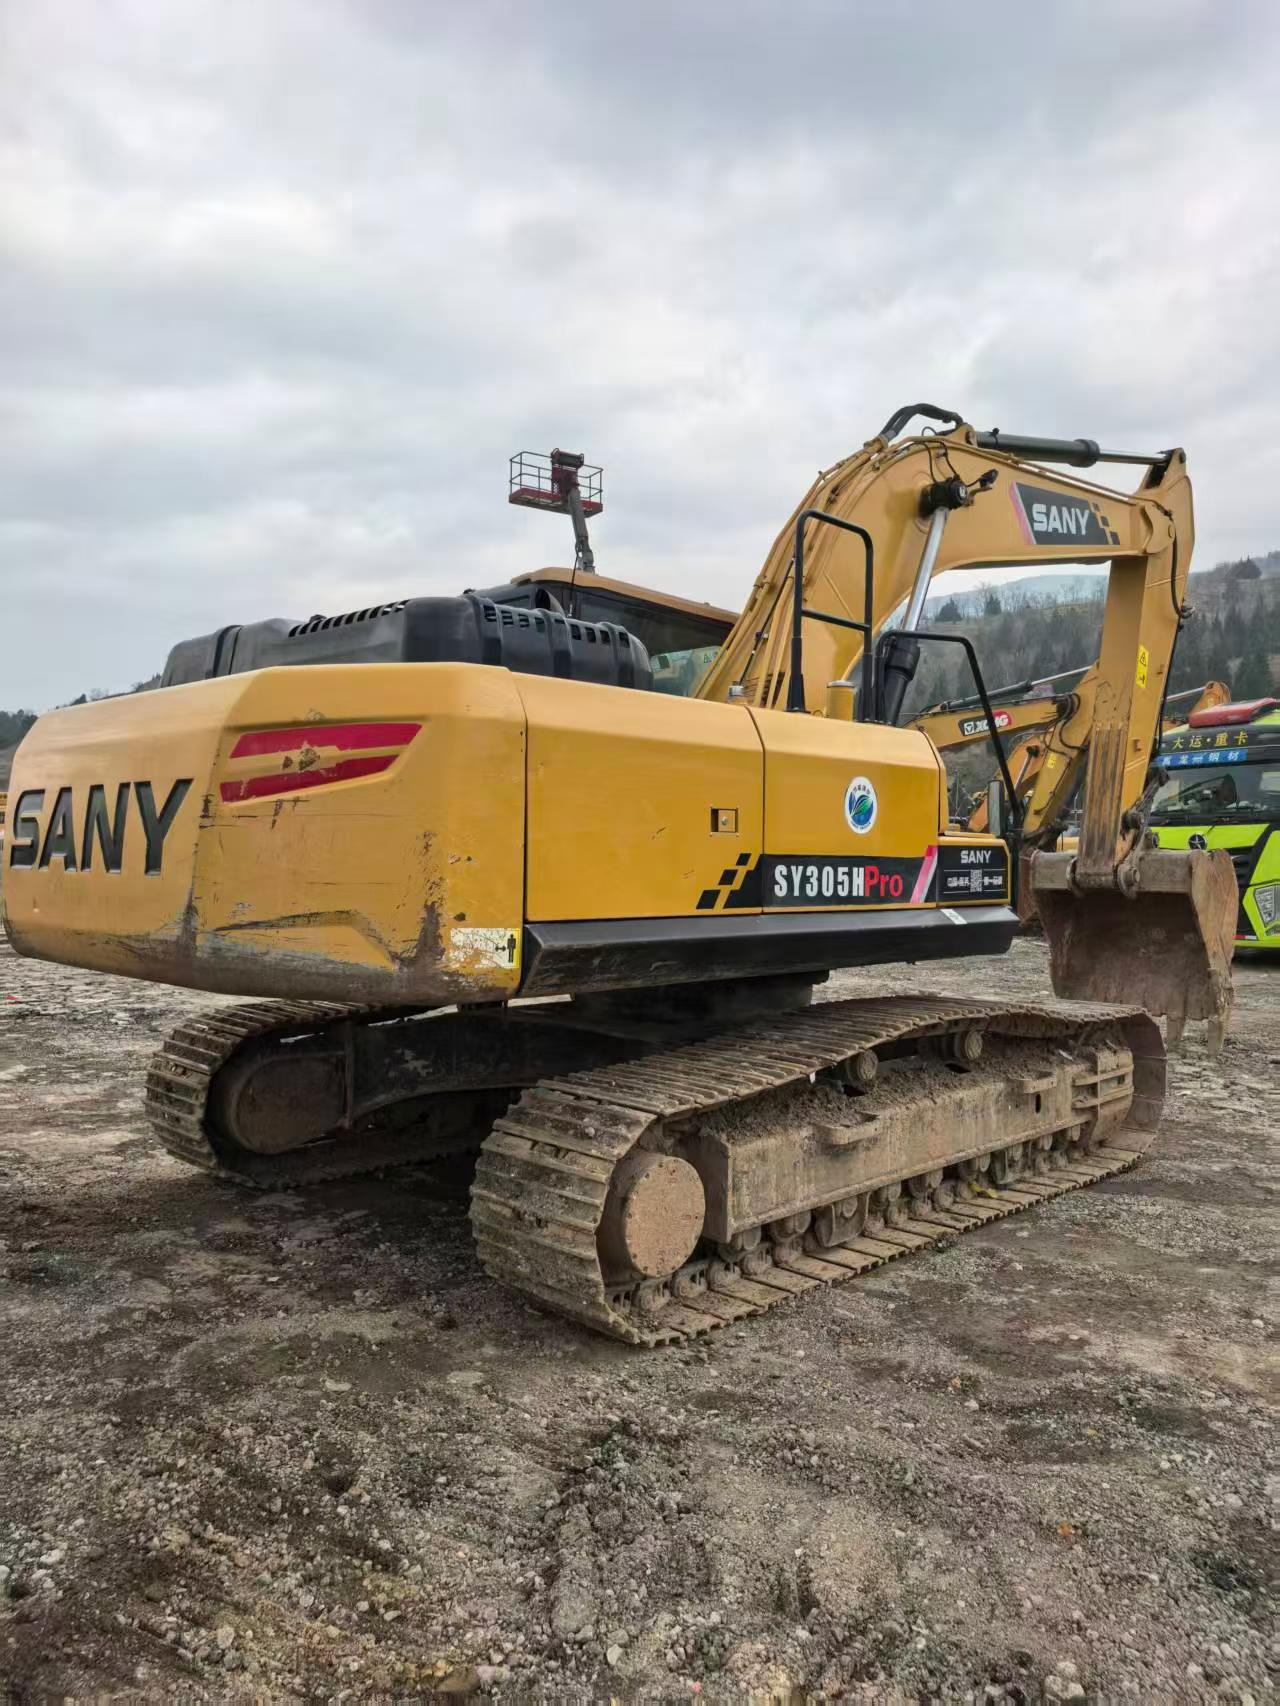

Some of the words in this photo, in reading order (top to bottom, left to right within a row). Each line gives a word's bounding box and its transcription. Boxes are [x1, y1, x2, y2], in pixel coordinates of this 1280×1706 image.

[1032, 503, 1090, 536] SANY
[10, 778, 195, 877] SANY
[960, 850, 992, 864] SANY
